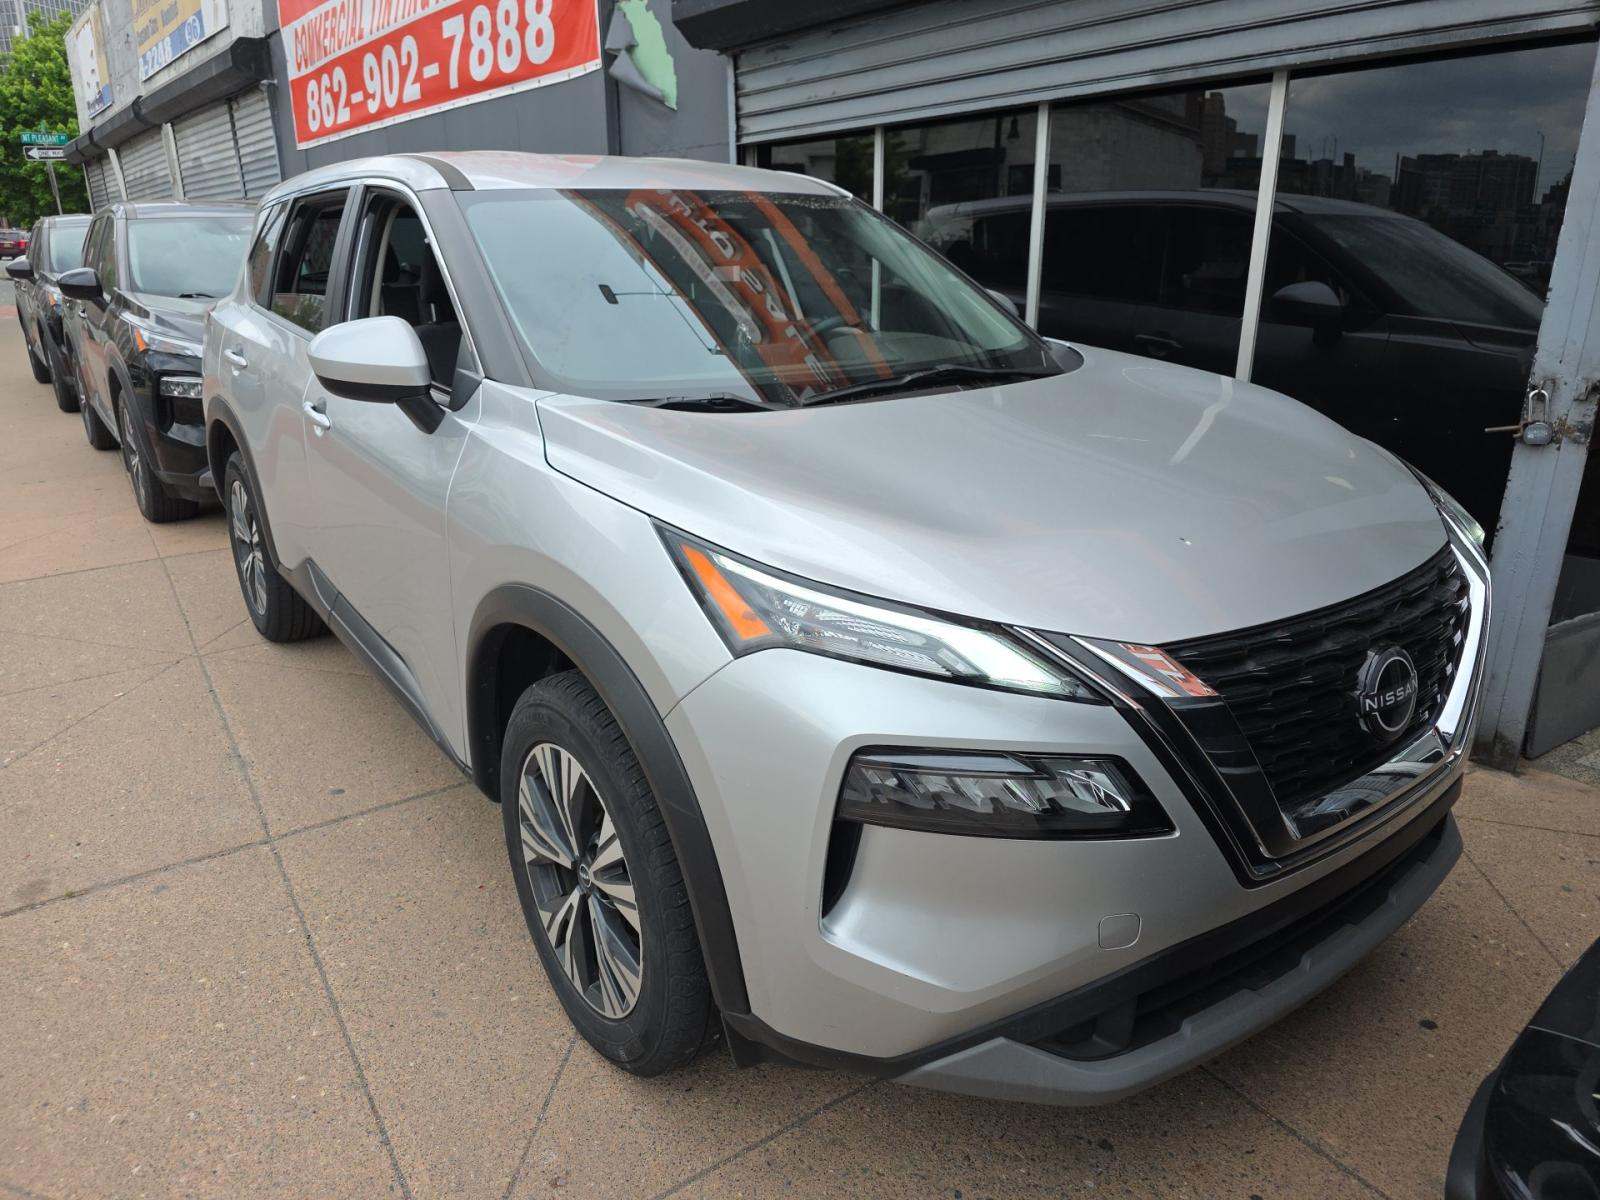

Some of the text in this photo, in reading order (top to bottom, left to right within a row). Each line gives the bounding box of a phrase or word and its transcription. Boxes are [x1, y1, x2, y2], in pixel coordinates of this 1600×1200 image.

[306, 0, 556, 132] 862-902-7888
[31, 133, 59, 143] PLEASANT
[1365, 678, 1418, 711] NISSAN
